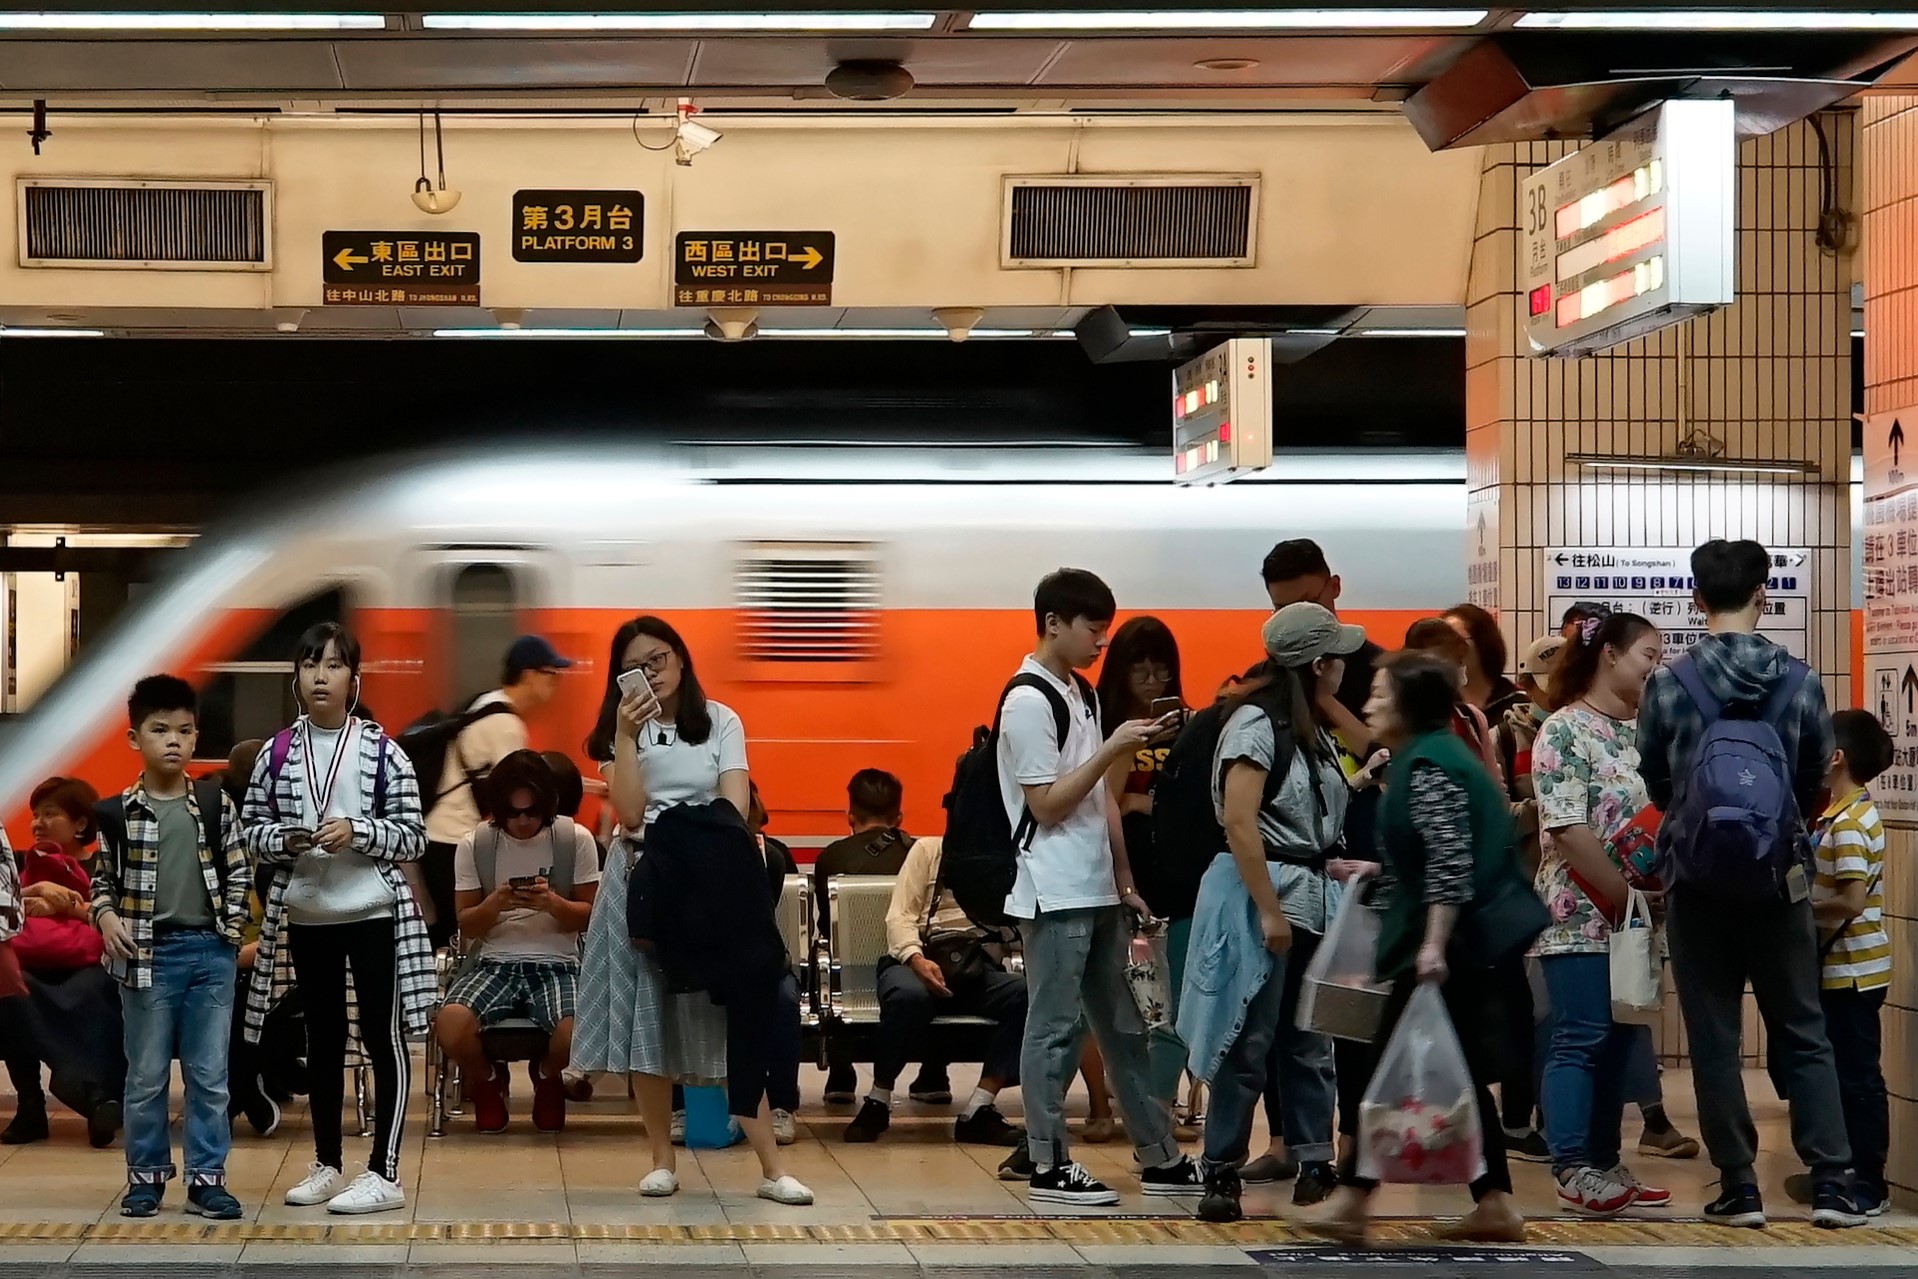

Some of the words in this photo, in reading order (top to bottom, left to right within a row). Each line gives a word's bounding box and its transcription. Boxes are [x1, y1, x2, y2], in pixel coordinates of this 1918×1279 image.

[1528, 183, 1547, 236] 3B
[521, 204, 633, 230] 第3月台
[521, 236, 616, 250] PLATFORM
[622, 236, 634, 250] 3
[370, 240, 472, 263] 東區出口
[684, 240, 787, 263] 西區出口
[382, 264, 424, 277] EAST
[429, 264, 466, 277] EXIT
[691, 265, 737, 277] WEST
[743, 265, 779, 277] EXIT
[326, 288, 406, 302] 往中山北路
[678, 289, 759, 303] 往重慶北路
[1572, 553, 1615, 568] 往松山
[1559, 577, 1571, 588] 13
[1577, 577, 1588, 588] 12
[1595, 577, 1607, 588] 11
[1614, 577, 1626, 588] 10
